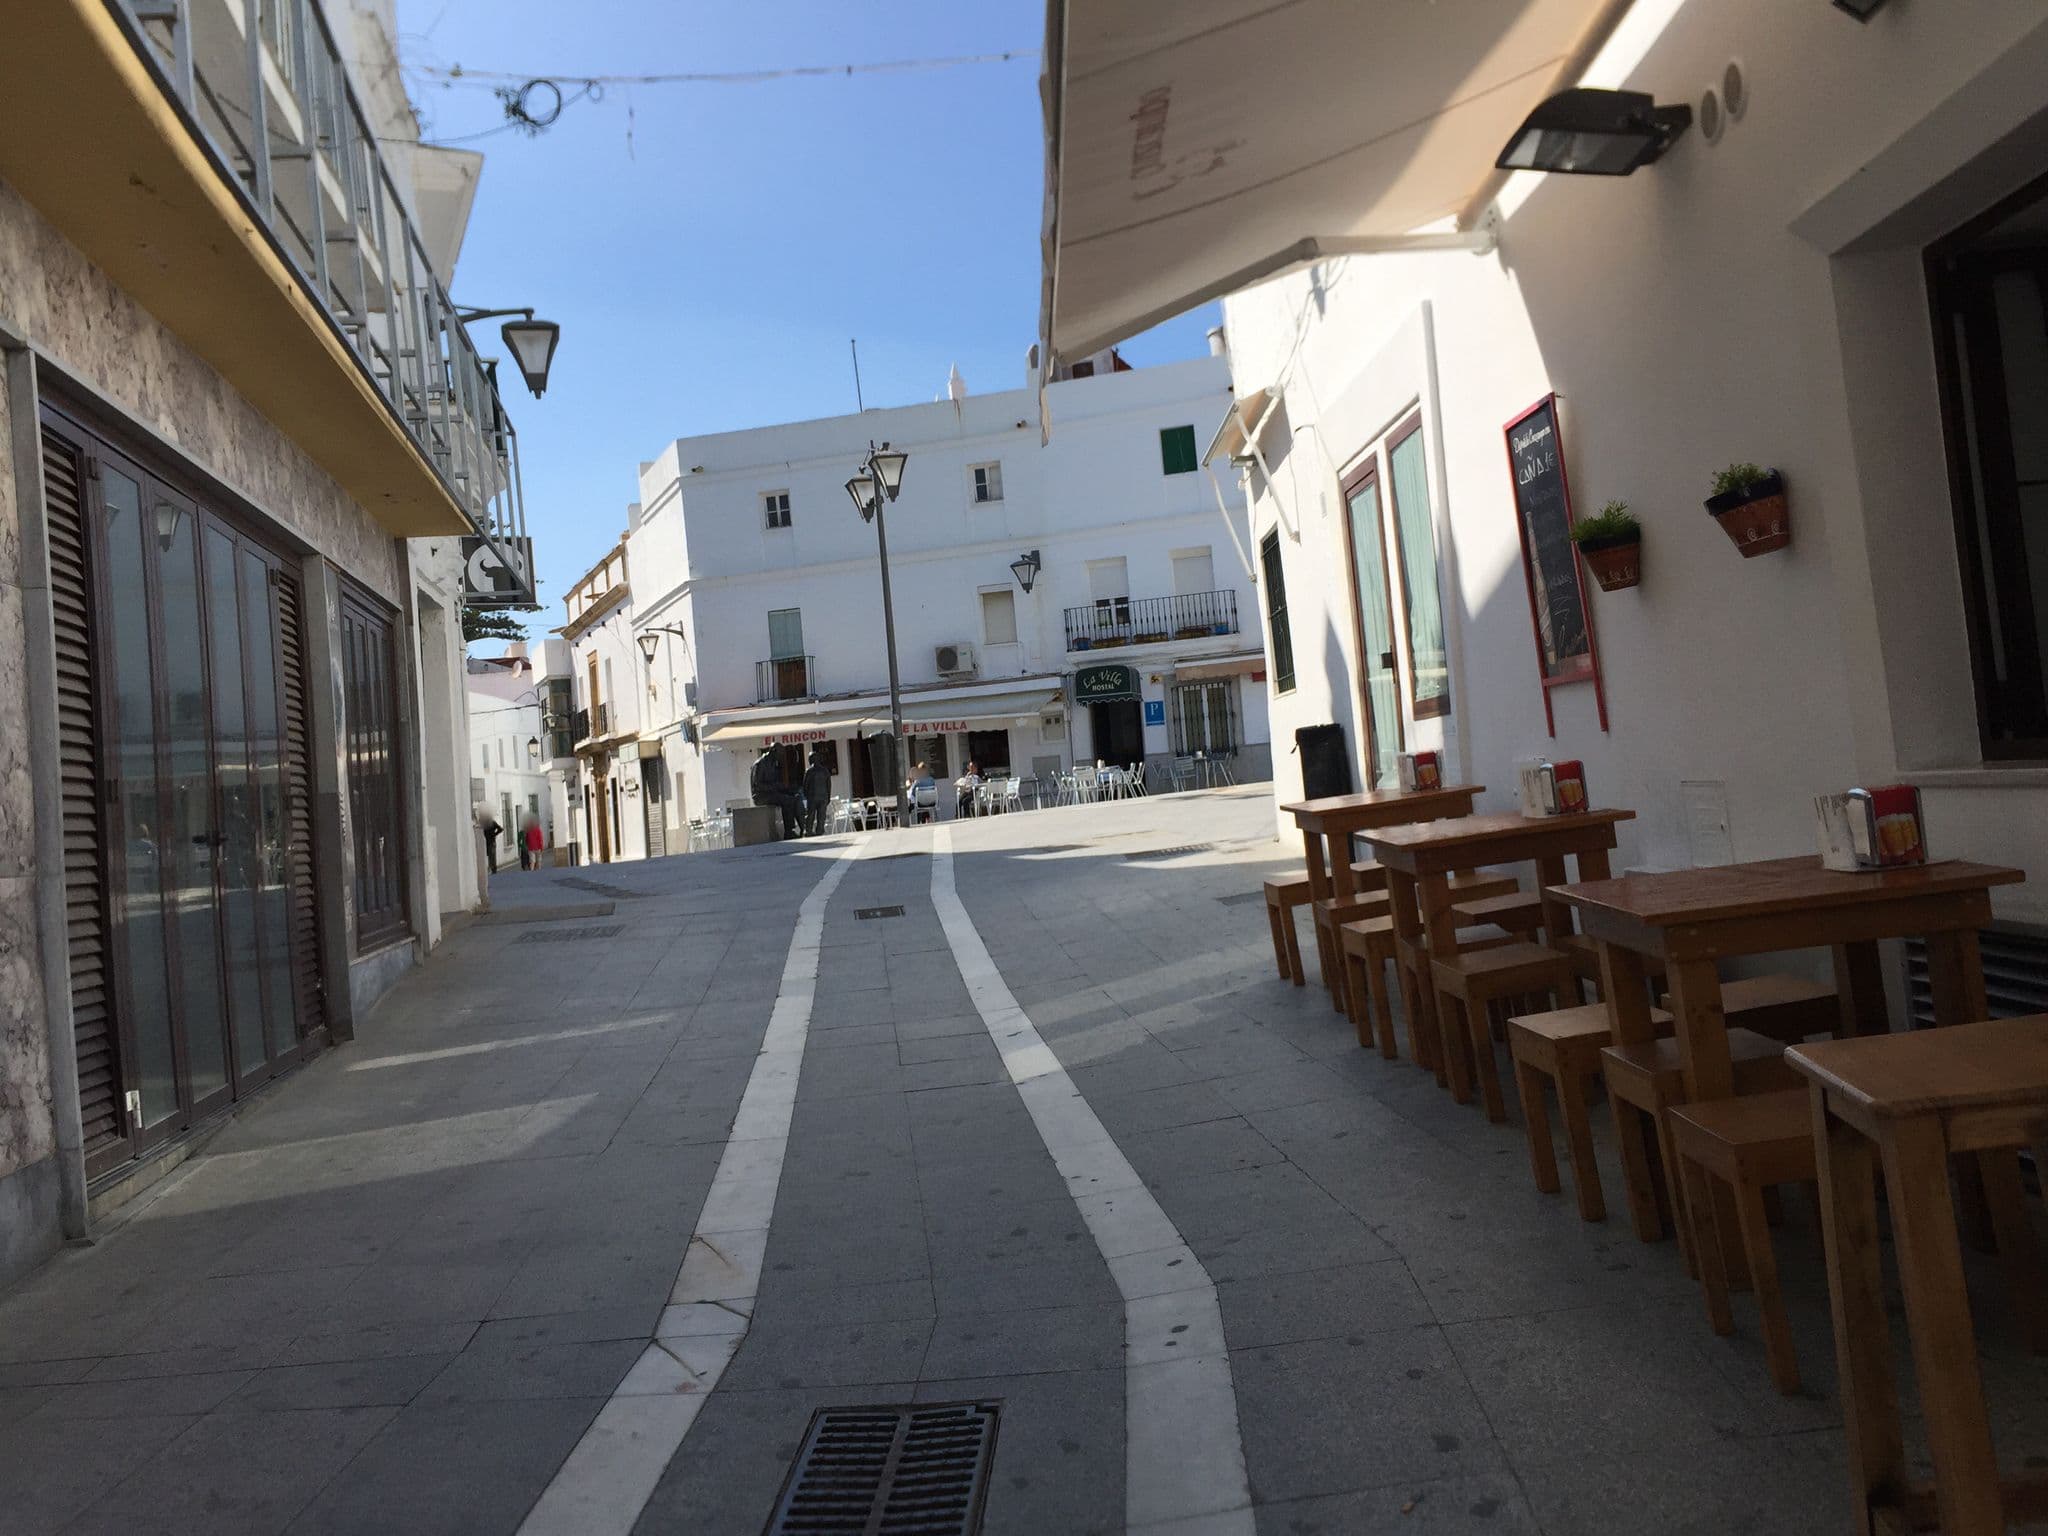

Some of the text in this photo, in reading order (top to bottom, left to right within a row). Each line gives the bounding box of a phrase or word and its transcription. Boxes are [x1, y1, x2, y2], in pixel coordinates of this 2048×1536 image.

[1519, 453, 1545, 485] CAÑA
[1083, 669, 1122, 689] La Villa
[1092, 683, 1115, 691] HOSTAL
[1150, 703, 1159, 716] P
[913, 723, 928, 732] LA
[932, 721, 968, 731] VILLA
[782, 730, 826, 744] RINCON
